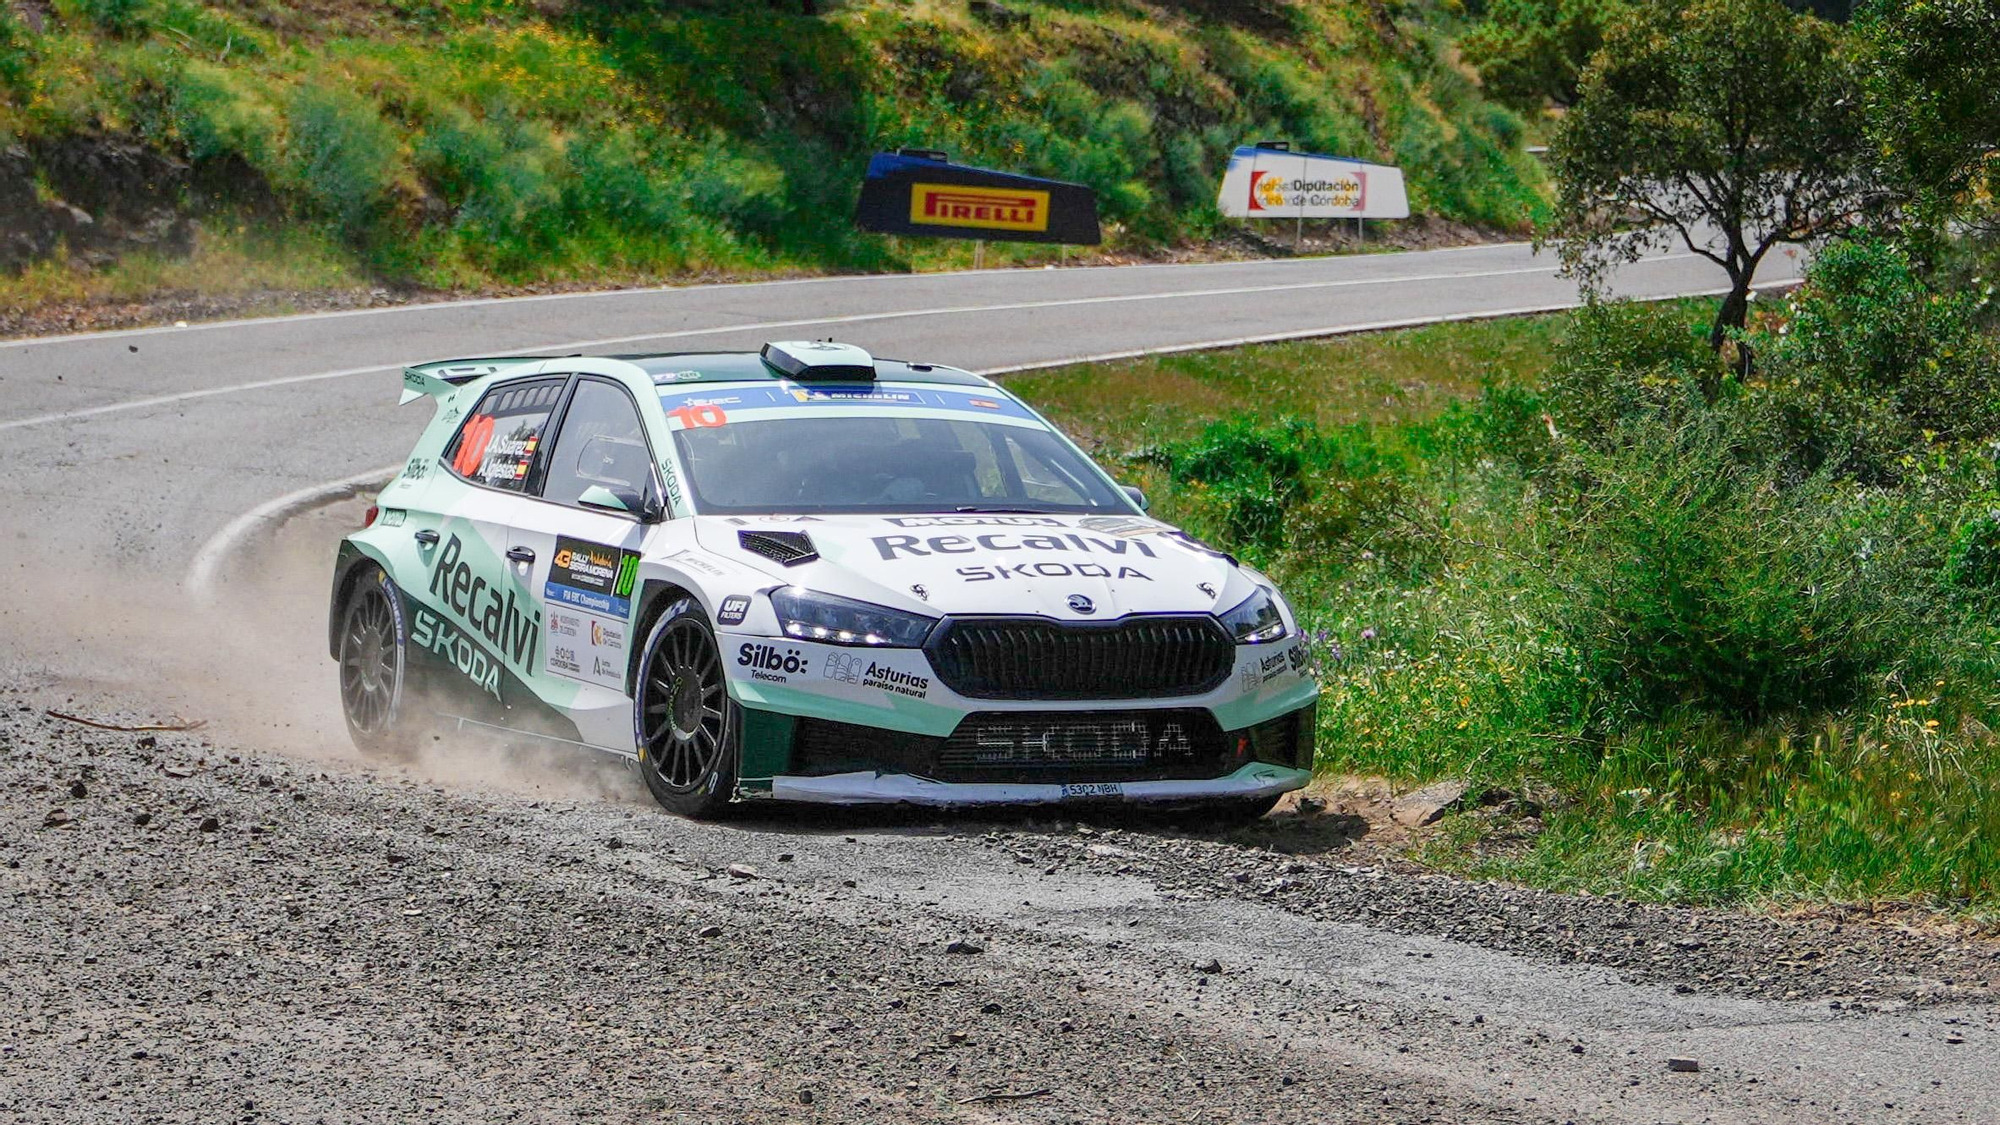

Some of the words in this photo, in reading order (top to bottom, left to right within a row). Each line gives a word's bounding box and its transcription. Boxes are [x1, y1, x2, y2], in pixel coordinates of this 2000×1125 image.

[1293, 179, 1359, 194] Diputación
[925, 192, 1037, 223] PIRELLI
[1292, 195, 1306, 207] de
[1310, 194, 1360, 207] Córdoba
[667, 406, 728, 429] 10
[453, 414, 495, 477] 10
[661, 458, 682, 508] SKODA
[900, 517, 1058, 528] MOTUL
[868, 532, 1163, 560] Recalvi
[554, 548, 572, 568] 43
[570, 551, 589, 563] RALLY
[616, 554, 640, 596] 10
[955, 563, 1155, 582] SKODA
[429, 532, 541, 677] Recalvi
[724, 600, 747, 612] UFI
[720, 612, 743, 620] FILTERS
[411, 609, 501, 702] SKODA
[751, 669, 787, 683] Telecom
[865, 661, 929, 689] Asturias
[894, 686, 927, 699] natural
[976, 721, 1192, 760] SKODA
[1069, 784, 1096, 795] 5302
[1098, 784, 1118, 794] NBH
